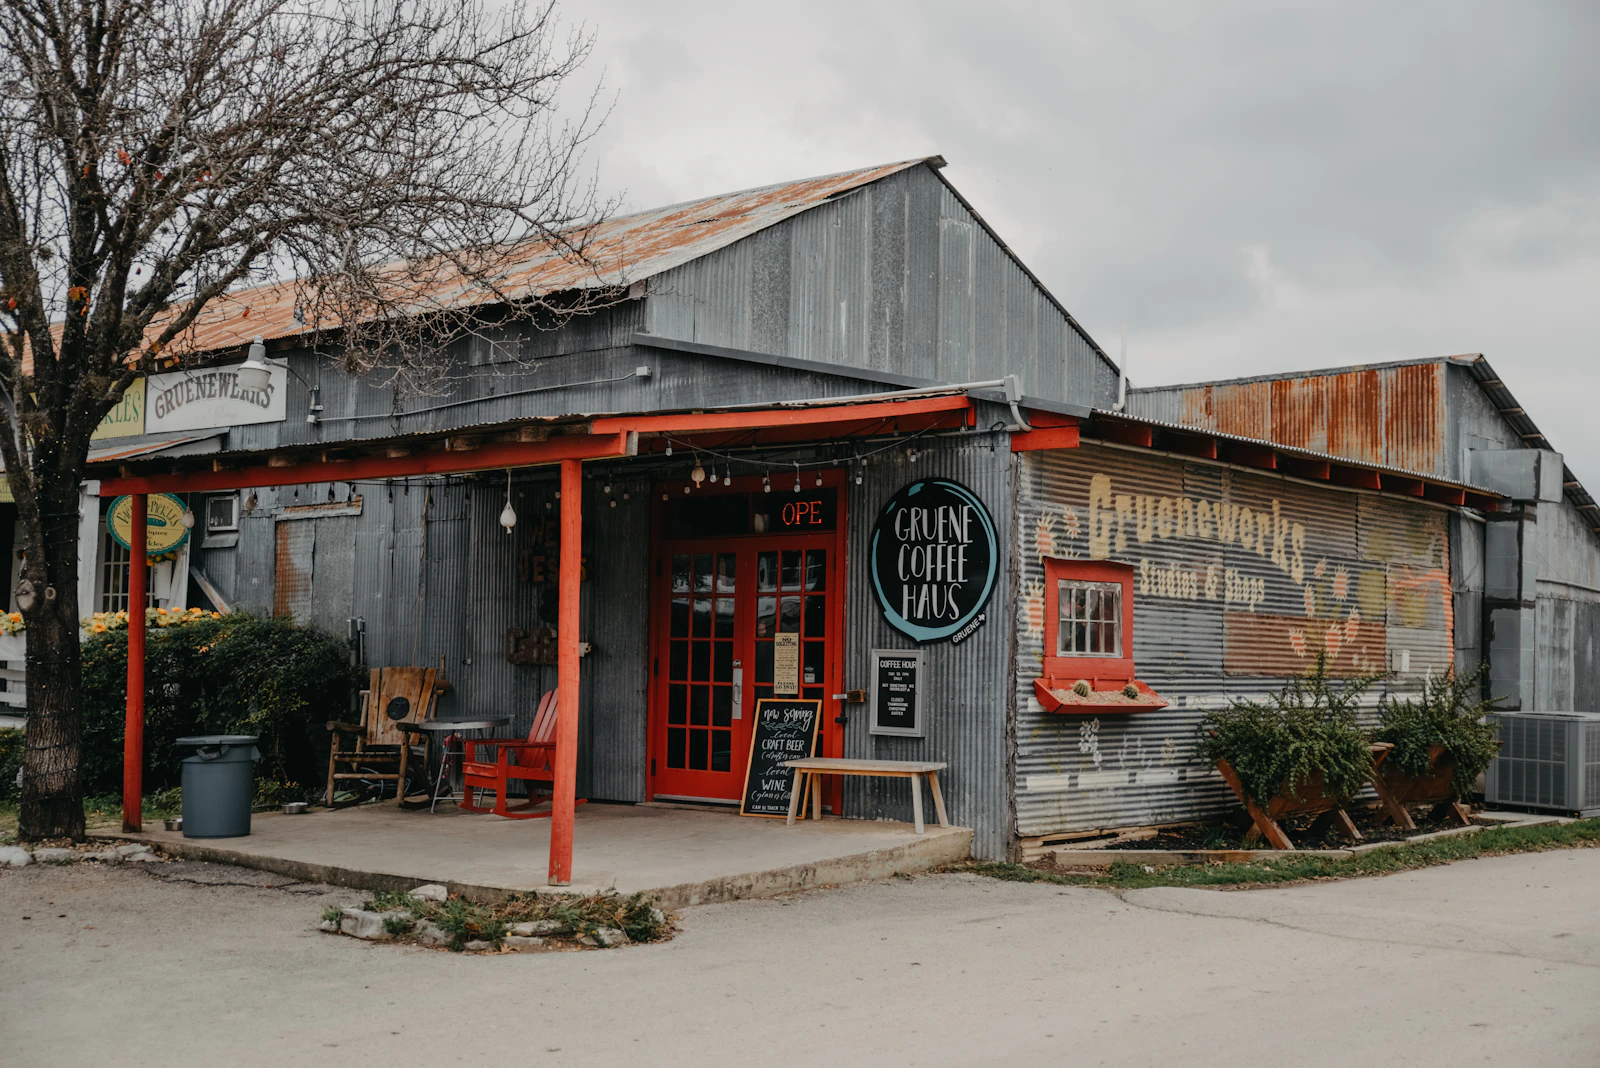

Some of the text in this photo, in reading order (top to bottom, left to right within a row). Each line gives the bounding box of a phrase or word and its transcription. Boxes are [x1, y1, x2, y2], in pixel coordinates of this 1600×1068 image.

[894, 504, 973, 544] GRUENE
[898, 543, 968, 583] COFFEE
[902, 583, 962, 620] HAUS
[952, 618, 980, 644] GRUENE
[880, 660, 901, 669] COFFEE
[761, 738, 805, 751] CRAFT BEER
[762, 779, 787, 791] WINE
